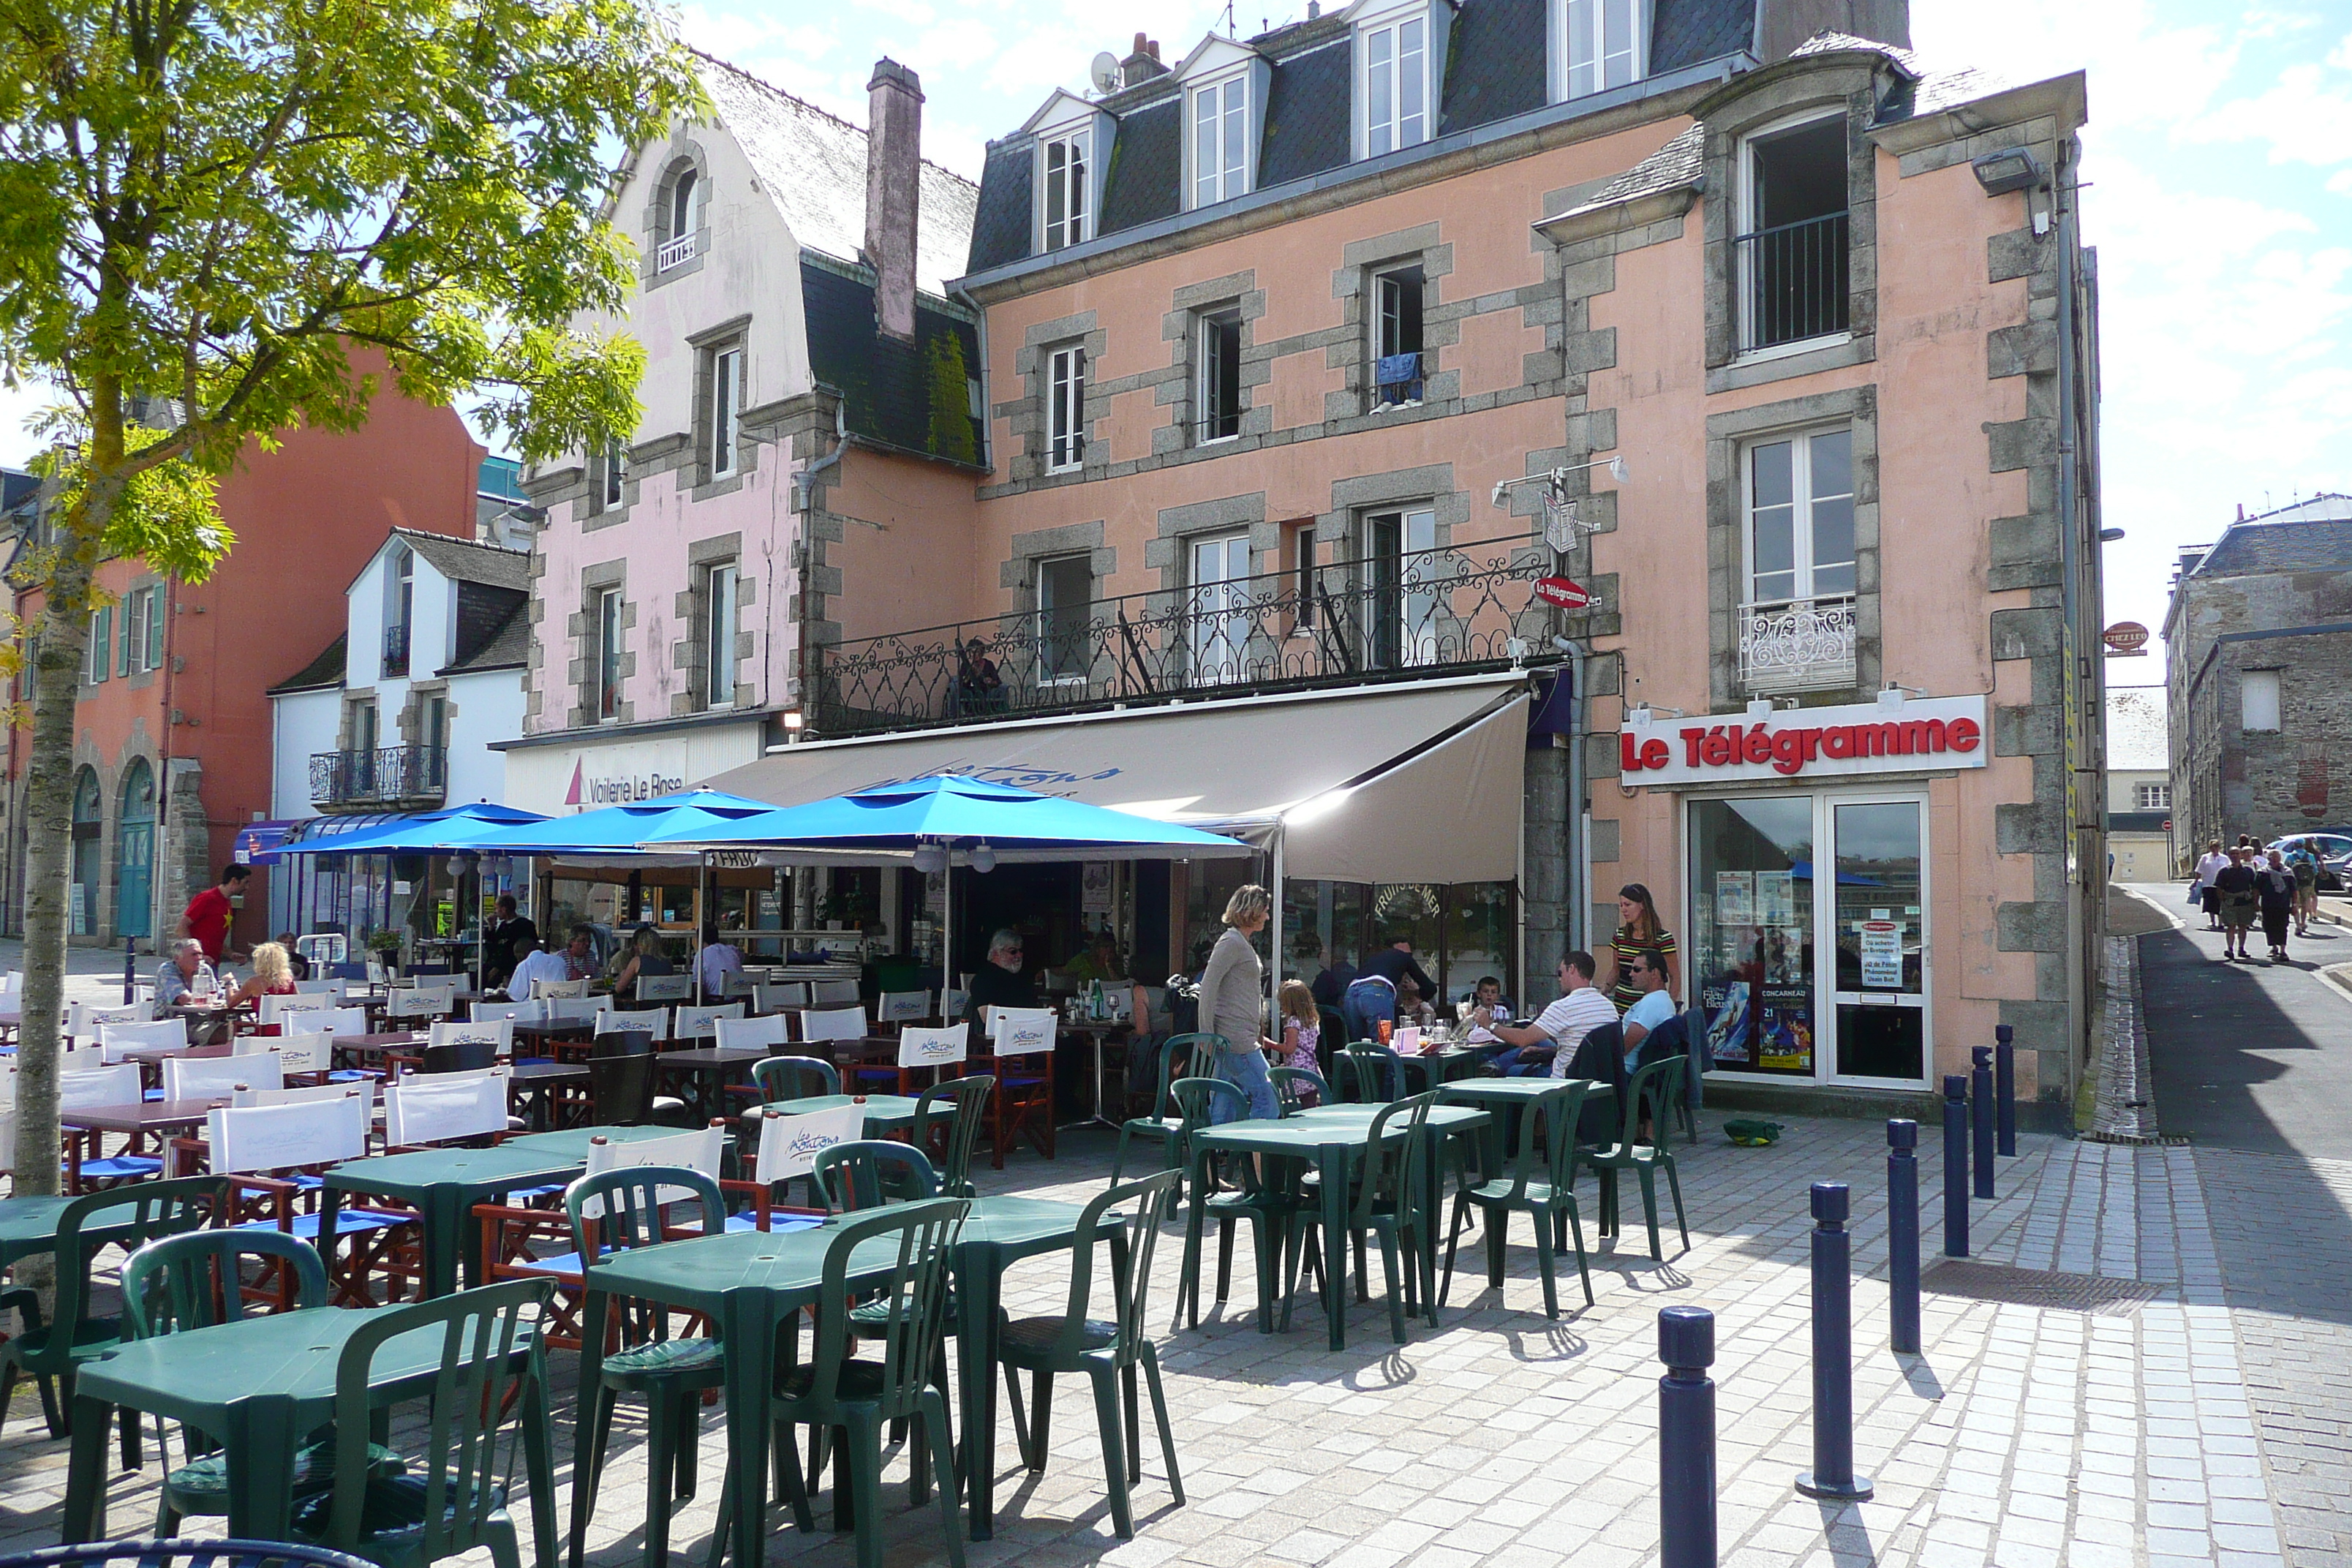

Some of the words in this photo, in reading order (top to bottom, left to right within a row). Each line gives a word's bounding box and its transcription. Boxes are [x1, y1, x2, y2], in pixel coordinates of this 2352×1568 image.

[1537, 582, 1545, 593] Le
[1546, 584, 1587, 602] Télégramme
[2105, 634, 2129, 642] CHEZ
[1622, 732, 1669, 771] Le
[1681, 717, 1980, 775] Télégramme
[2065, 630, 2076, 855] RESTAURANT
[590, 776, 631, 803] Voilerie
[634, 774, 647, 801] Le
[652, 773, 682, 798] Rose
[1421, 885, 1440, 919] MER
[1703, 990, 1725, 1000] Filets
[1764, 1008, 1774, 1017] 21
